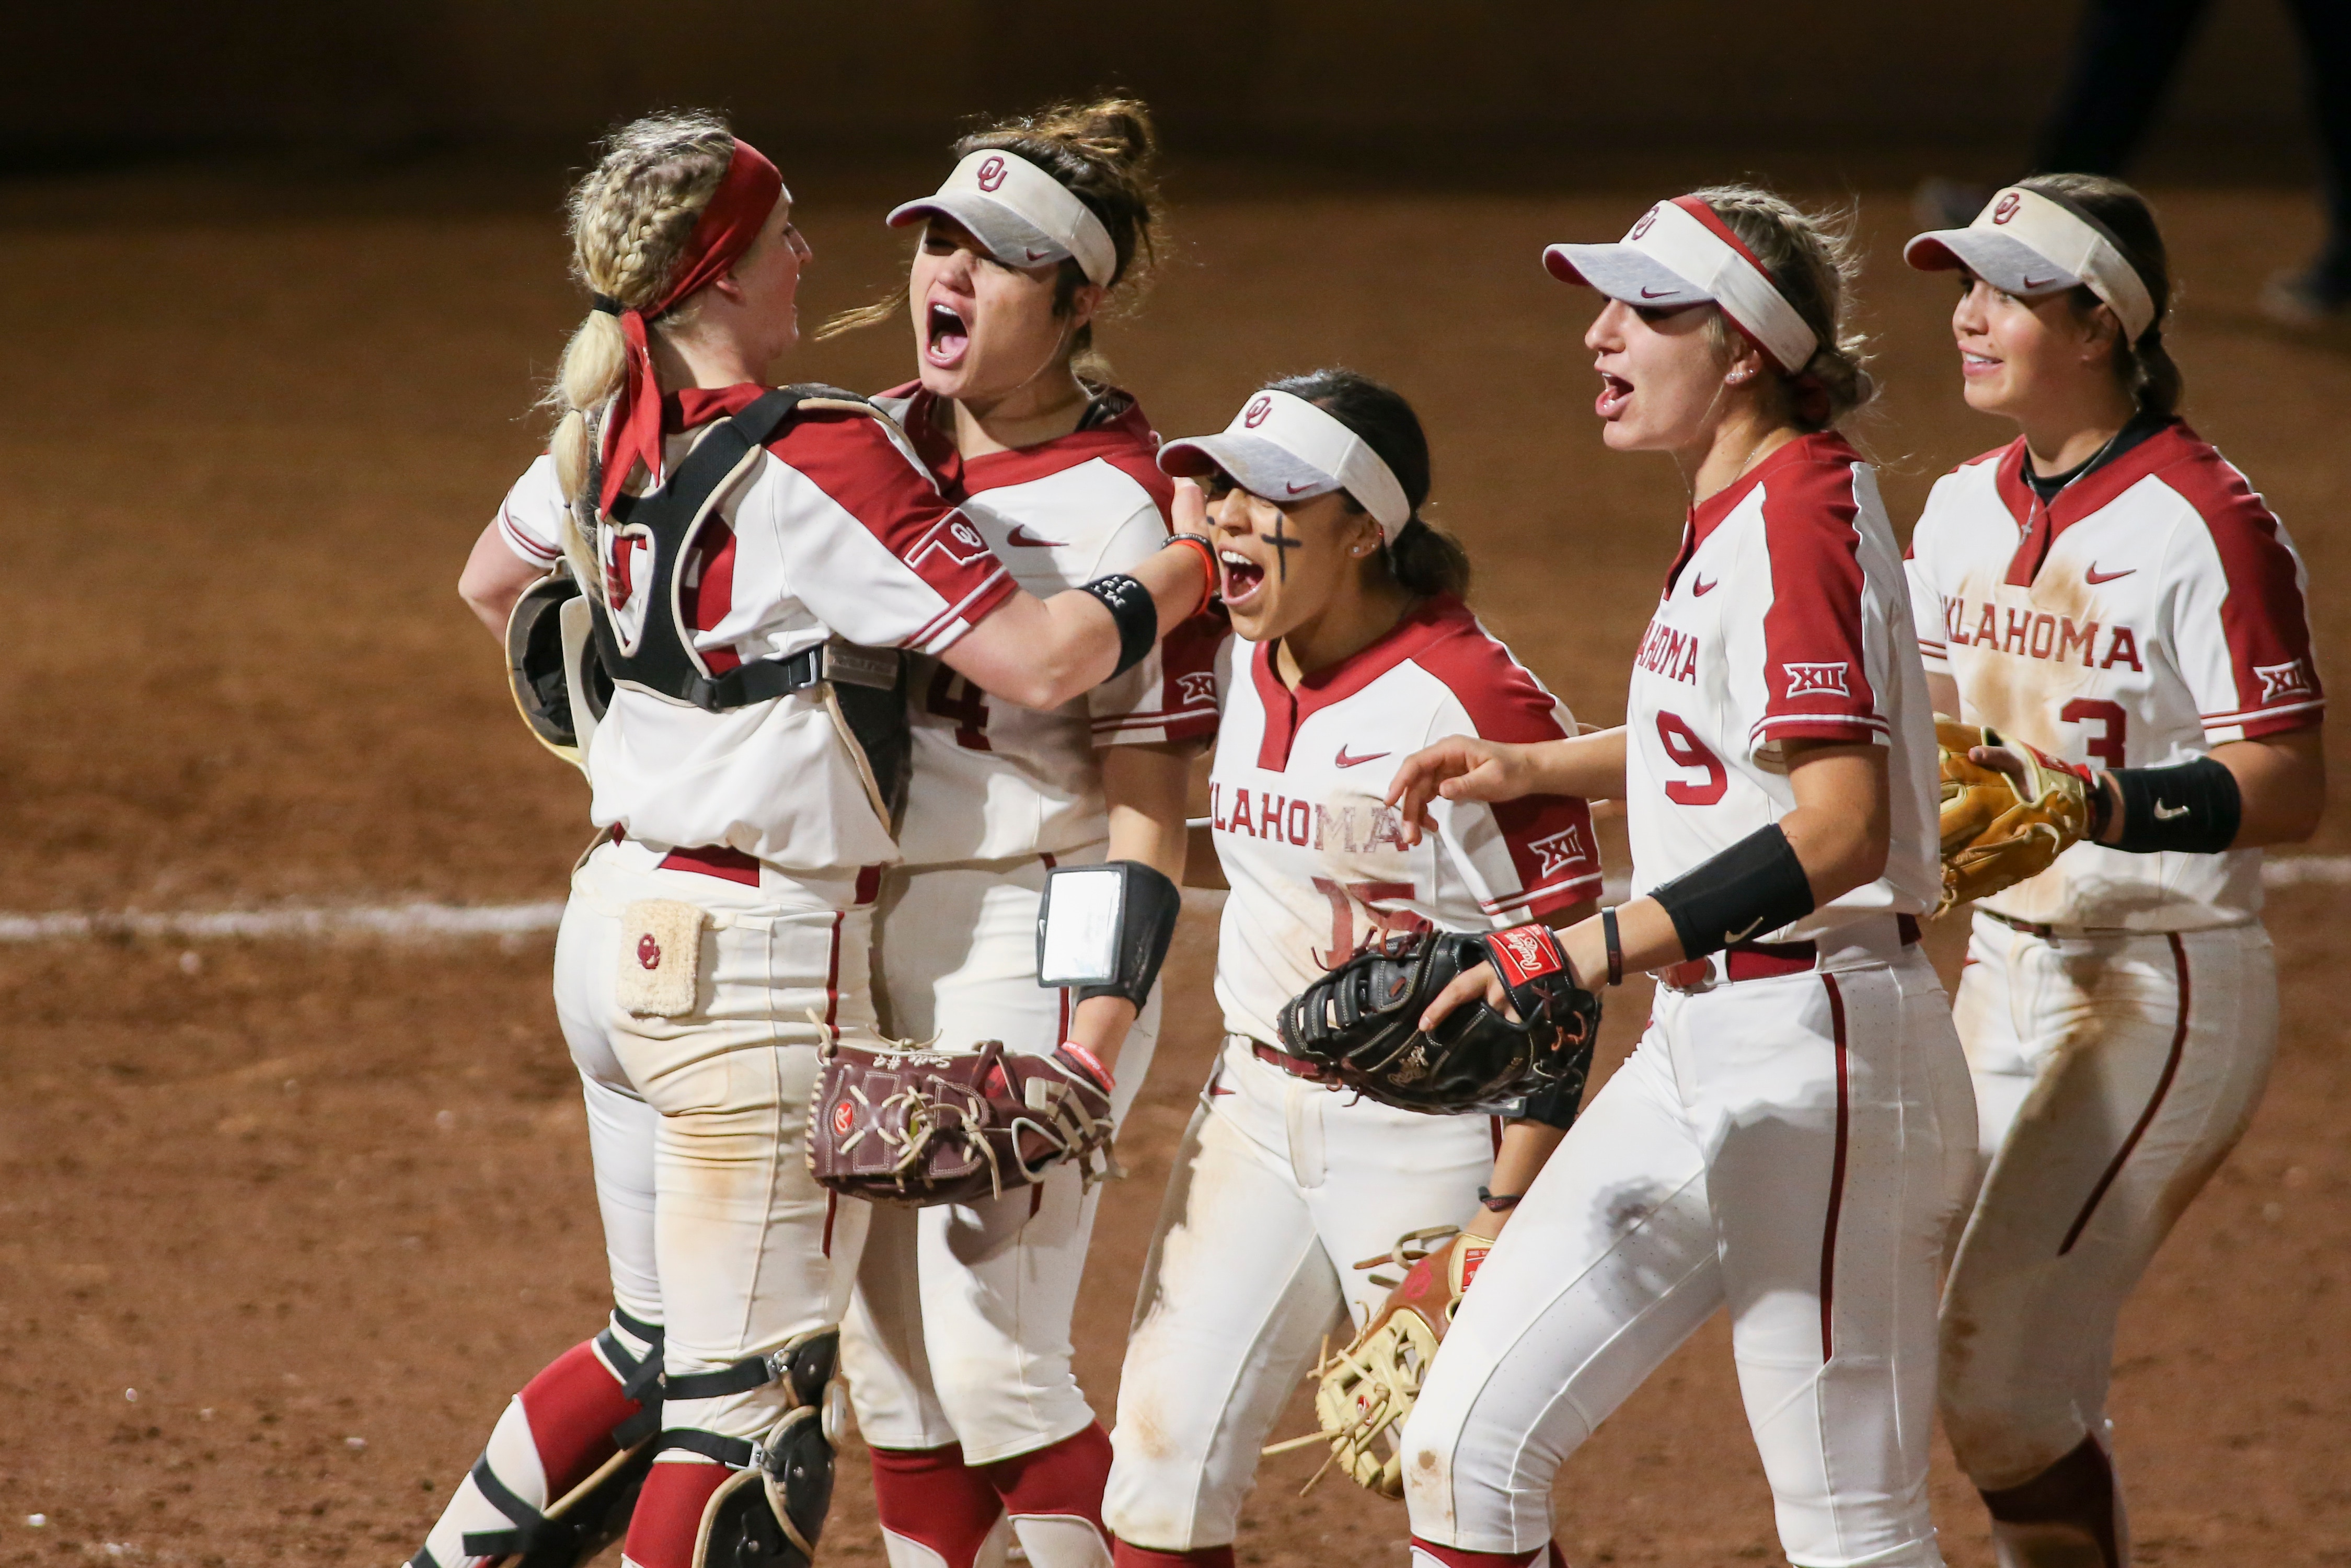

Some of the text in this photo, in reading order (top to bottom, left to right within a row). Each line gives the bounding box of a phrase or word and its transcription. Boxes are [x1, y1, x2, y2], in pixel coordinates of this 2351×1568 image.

[977, 156, 1008, 192] OU
[1631, 205, 1660, 240] OU
[1992, 192, 2021, 225] OU
[1244, 396, 1272, 429] OU
[950, 522, 982, 547] OU
[1942, 595, 2143, 672] KLAHOMA
[1782, 662, 1851, 699] XII
[926, 660, 992, 751] 4
[2060, 697, 2128, 769] 3
[1656, 709, 1728, 805] 9
[1209, 781, 1409, 853] LAHOMA
[1527, 824, 1586, 880] XII
